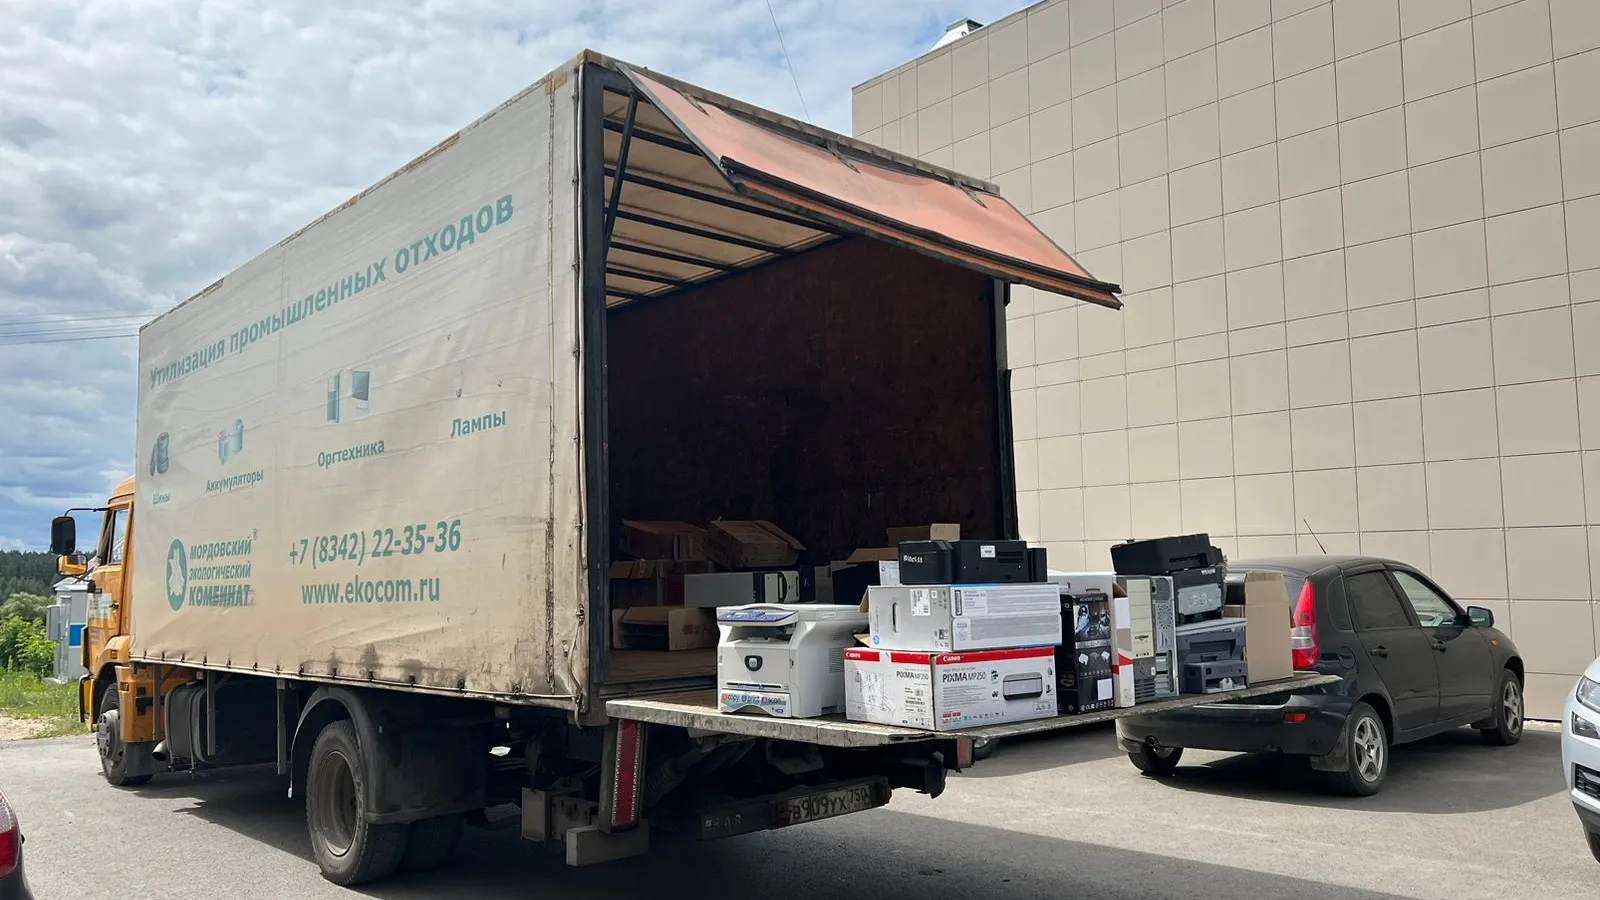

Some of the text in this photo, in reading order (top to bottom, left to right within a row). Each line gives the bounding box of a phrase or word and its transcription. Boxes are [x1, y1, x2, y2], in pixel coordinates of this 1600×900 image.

[150, 339, 225, 389] Утилизация
[230, 257, 387, 354] промышленных
[450, 411, 506, 438] Лампы
[318, 440, 385, 469] Оргтехника
[205, 470, 264, 492] Аккумуляторы
[189, 535, 252, 561] МОРДОВСКИЙ
[289, 519, 461, 570] +7 (8342) 22-35-36
[189, 560, 252, 580] ЭКОЛОГИЧЕСКИЙ
[188, 584, 251, 607] КОМБИНАТ
[301, 575, 440, 604] www.ekocom.ru
[896, 670, 914, 679] PIXMA
[942, 671, 987, 683] PIXMA MP250
